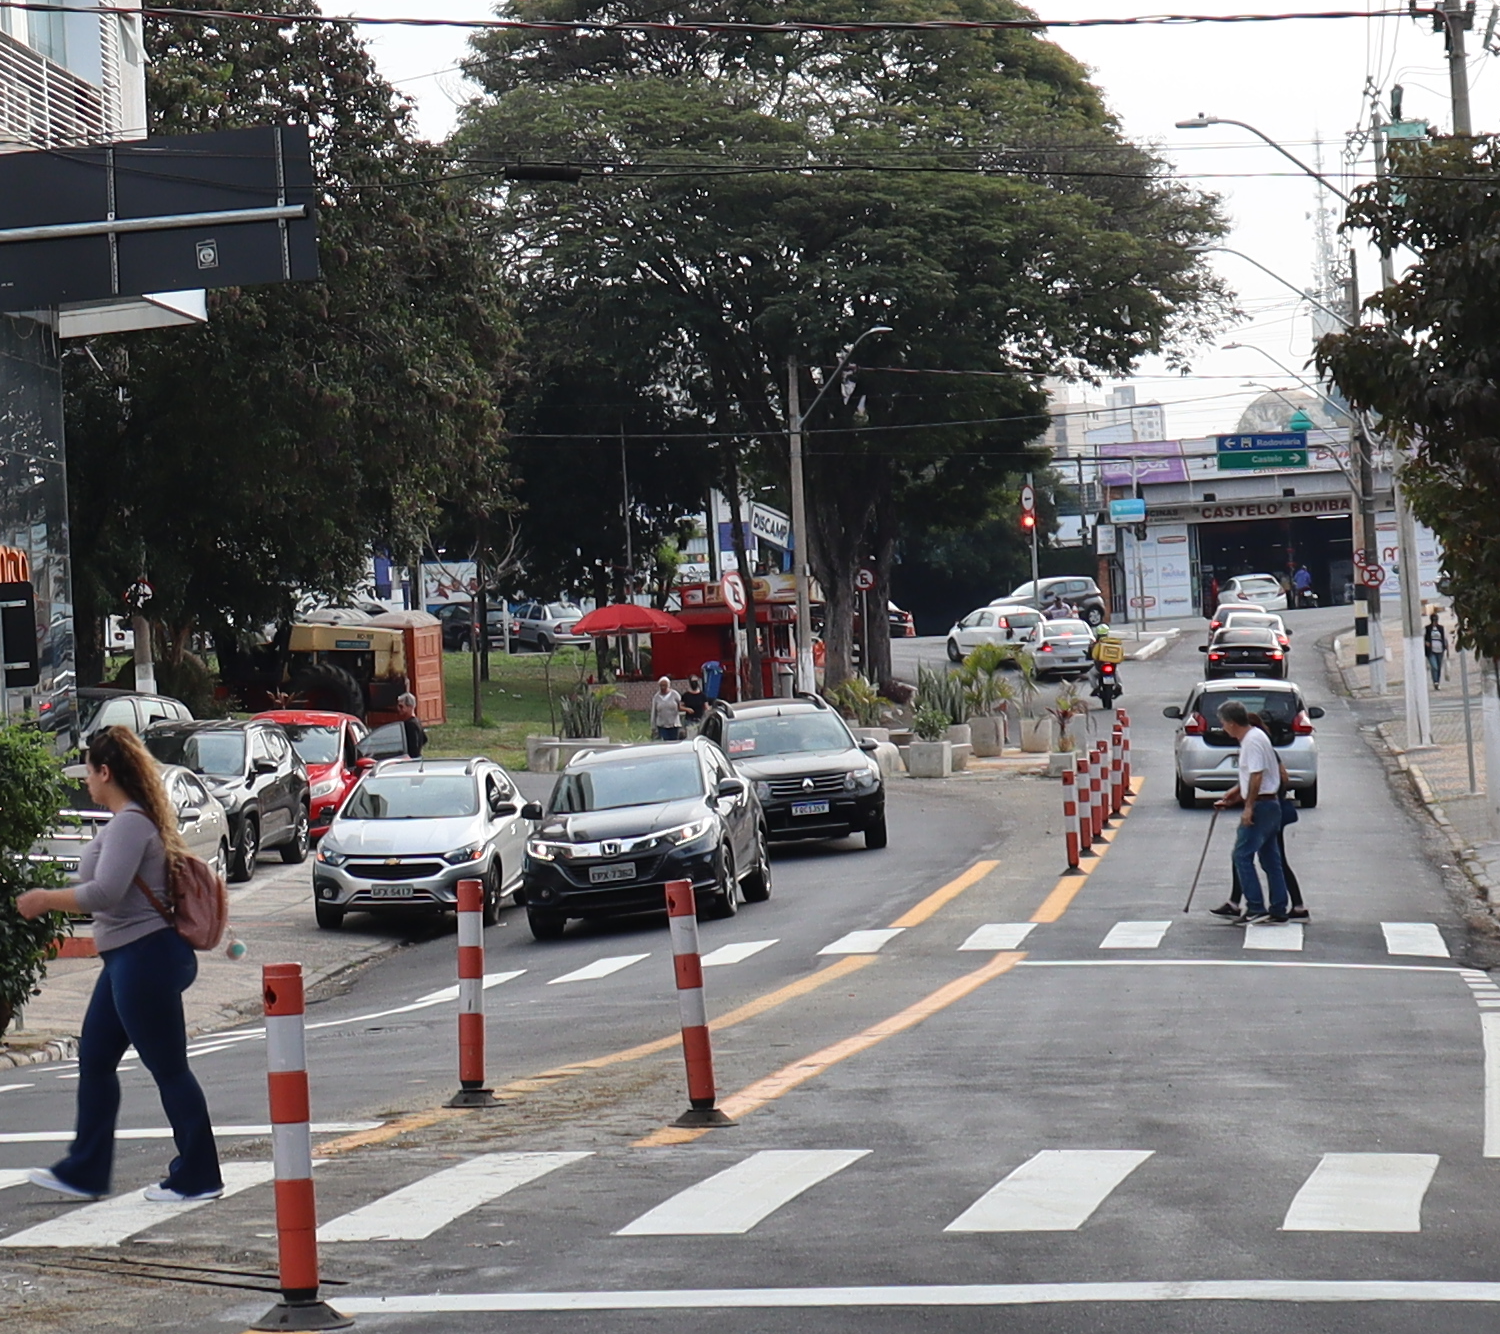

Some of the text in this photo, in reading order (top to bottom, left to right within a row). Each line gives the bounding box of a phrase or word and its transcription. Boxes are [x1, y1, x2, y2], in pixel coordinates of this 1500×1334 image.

[1256, 437, 1301, 447] Rodoviária
[1251, 454, 1283, 464] Castelo
[752, 511, 788, 540] DISCAMP
